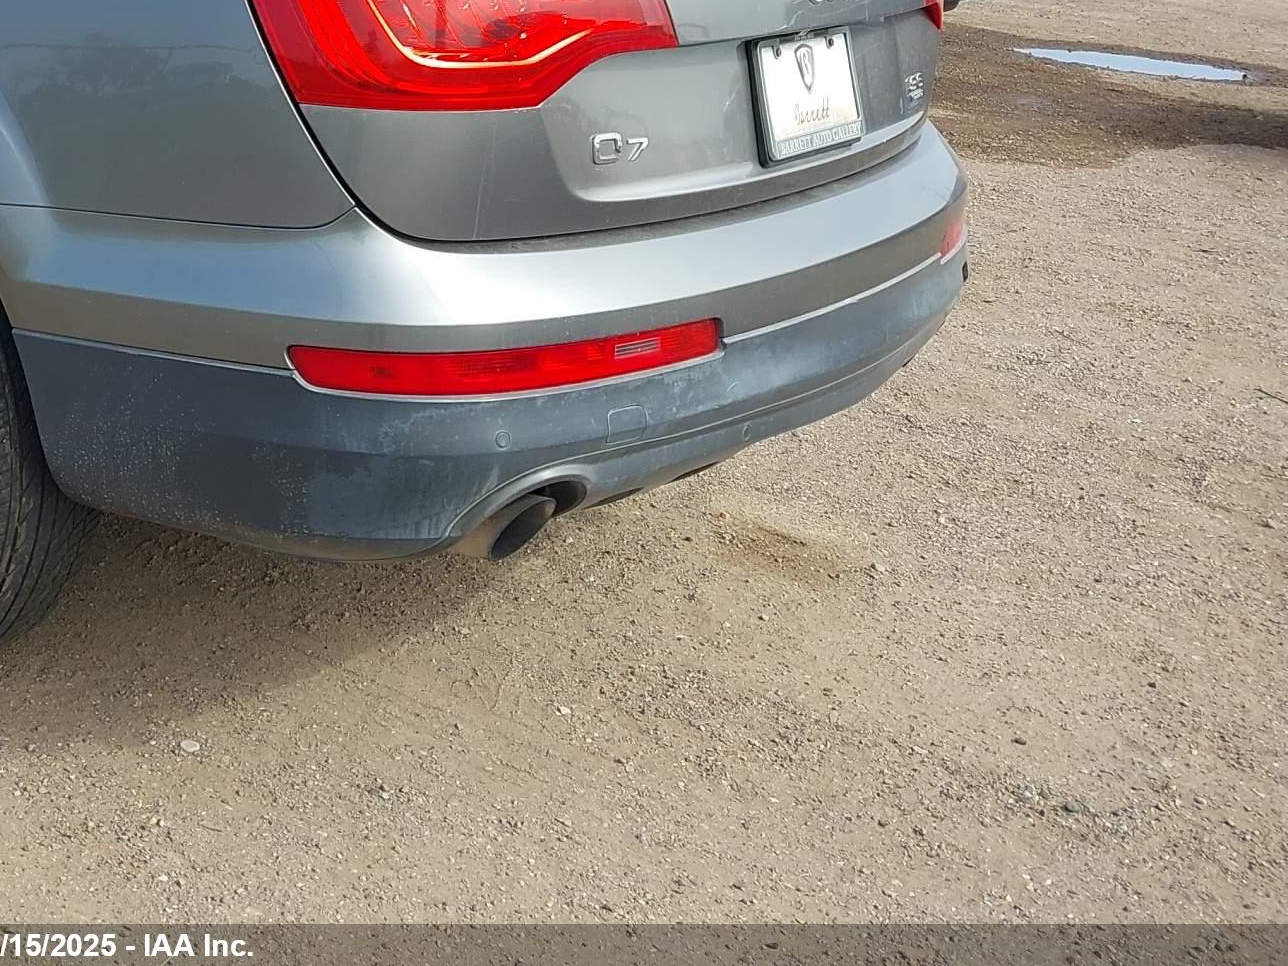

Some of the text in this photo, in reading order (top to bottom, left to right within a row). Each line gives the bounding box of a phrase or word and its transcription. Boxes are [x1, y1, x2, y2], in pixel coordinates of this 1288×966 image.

[591, 132, 649, 165] Q7
[781, 124, 861, 155] BARRETT AUTO GALLERY
